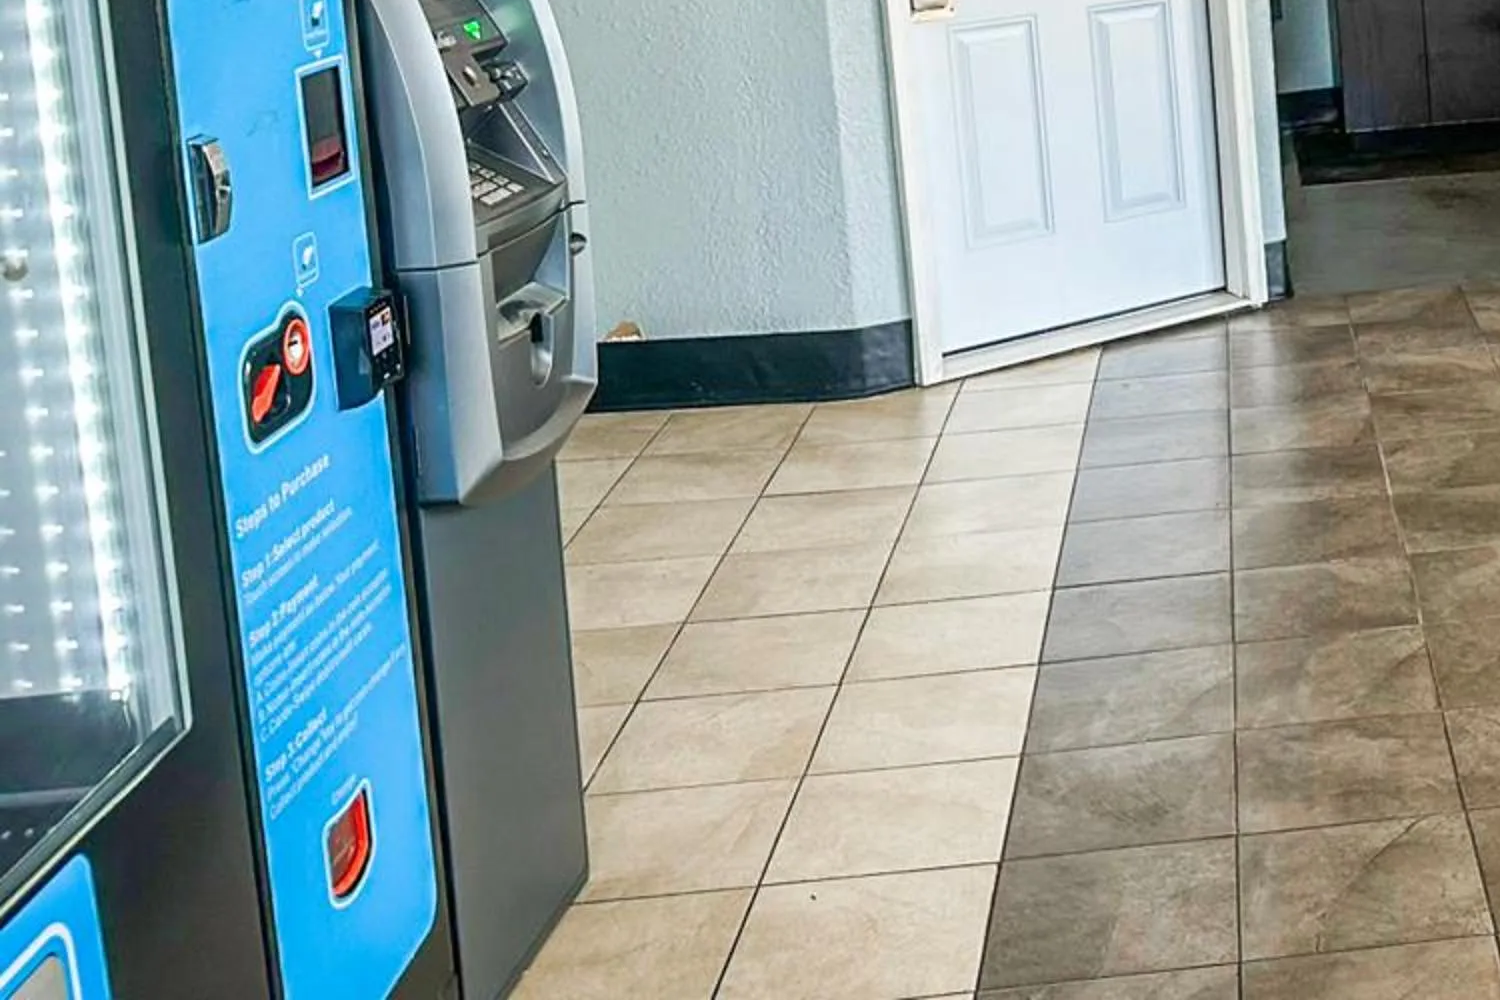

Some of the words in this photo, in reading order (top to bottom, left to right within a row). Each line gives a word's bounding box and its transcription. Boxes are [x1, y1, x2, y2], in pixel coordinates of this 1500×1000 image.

[235, 503, 268, 539] Steps
[268, 493, 281, 512] to
[281, 453, 330, 501] Purchase
[241, 561, 264, 588] Step
[250, 621, 272, 646] Step
[265, 752, 288, 782] Step
